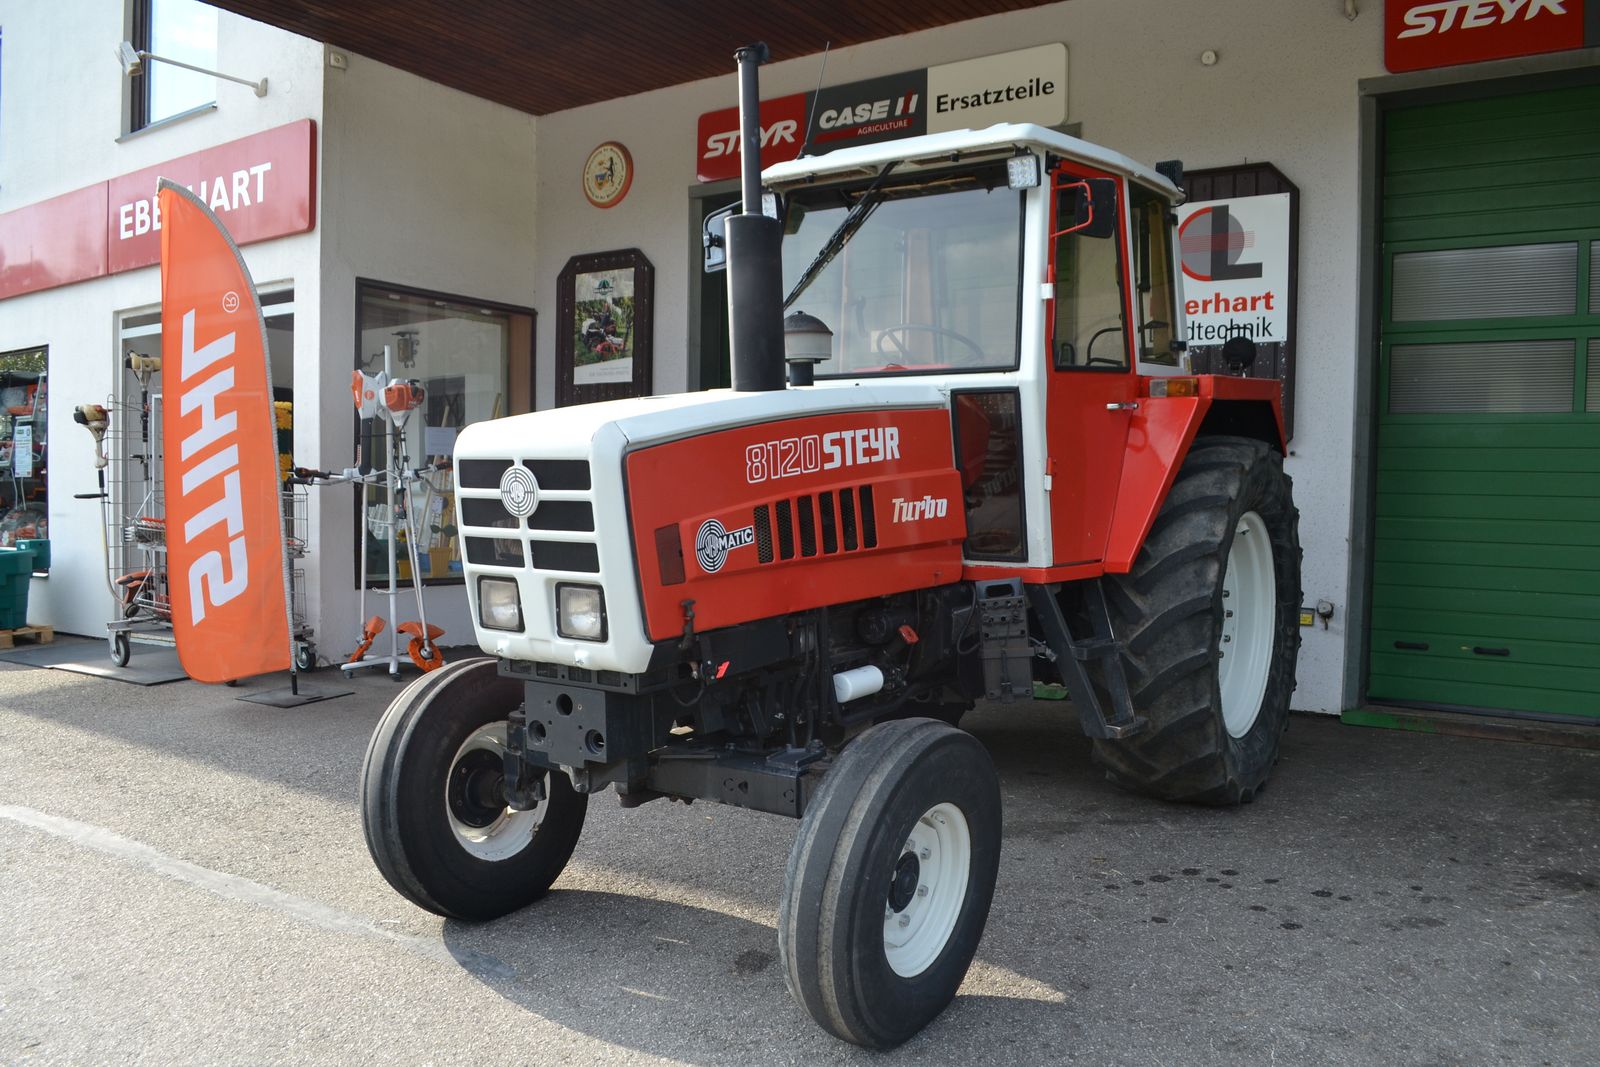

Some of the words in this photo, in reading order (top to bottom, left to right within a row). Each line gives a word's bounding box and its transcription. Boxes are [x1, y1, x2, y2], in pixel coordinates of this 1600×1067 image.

[1397, 0, 1567, 40] STEYR
[936, 78, 1055, 113] Ersatzteile
[819, 99, 890, 129] CASE
[857, 119, 908, 135] AGRICULTURE
[703, 119, 797, 159] STYR
[1185, 290, 1274, 315] erhart
[1187, 316, 1272, 340] dtechnik
[745, 433, 821, 484] 8120
[822, 426, 901, 471] STEYR
[892, 495, 948, 524] Turbo
[719, 528, 753, 551] MATIC
